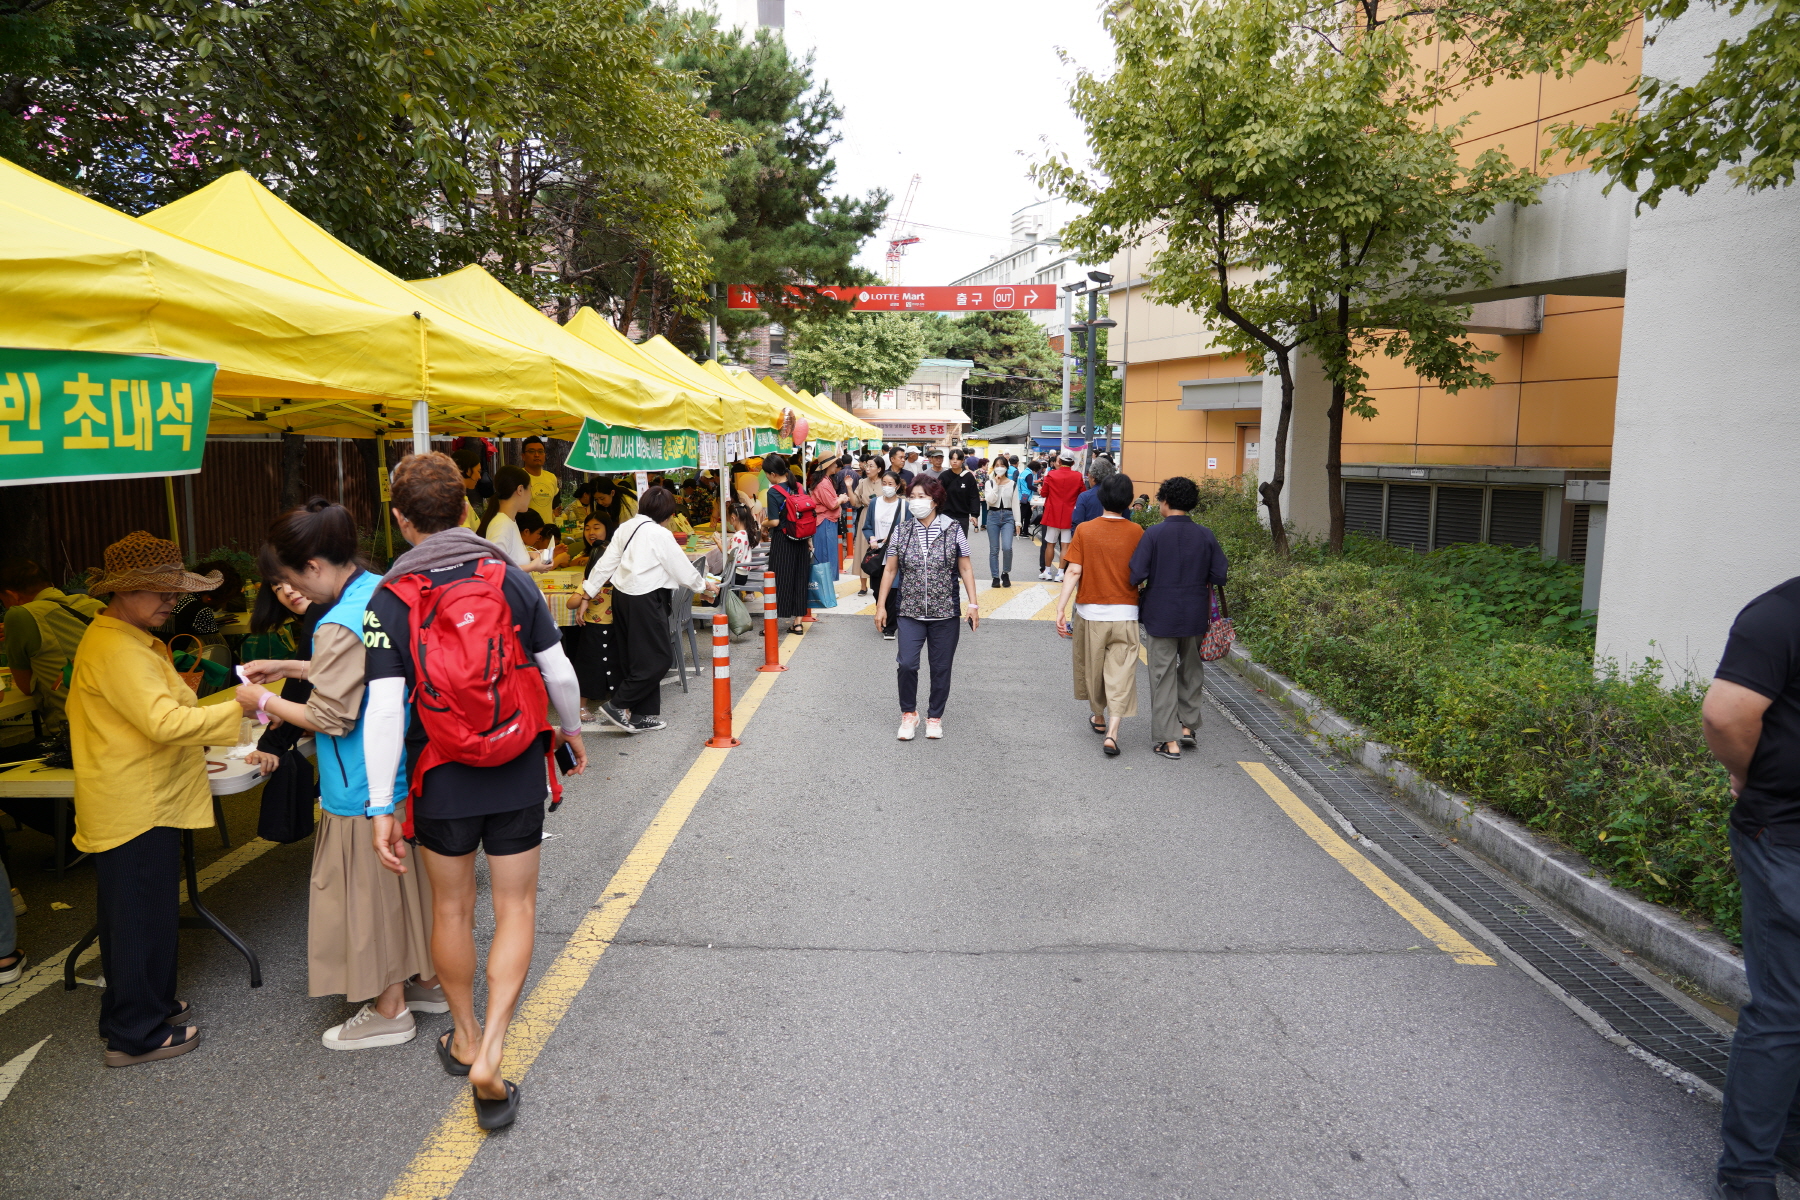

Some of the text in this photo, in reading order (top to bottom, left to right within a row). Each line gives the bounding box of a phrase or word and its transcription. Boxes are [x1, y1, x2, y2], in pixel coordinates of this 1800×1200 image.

[871, 292, 925, 301] LOTTE Mart
[956, 292, 983, 306] 출구
[996, 293, 1012, 303] OUT
[63, 372, 193, 452] 초대석
[1080, 424, 1107, 435] G25
[362, 631, 391, 649] ort
